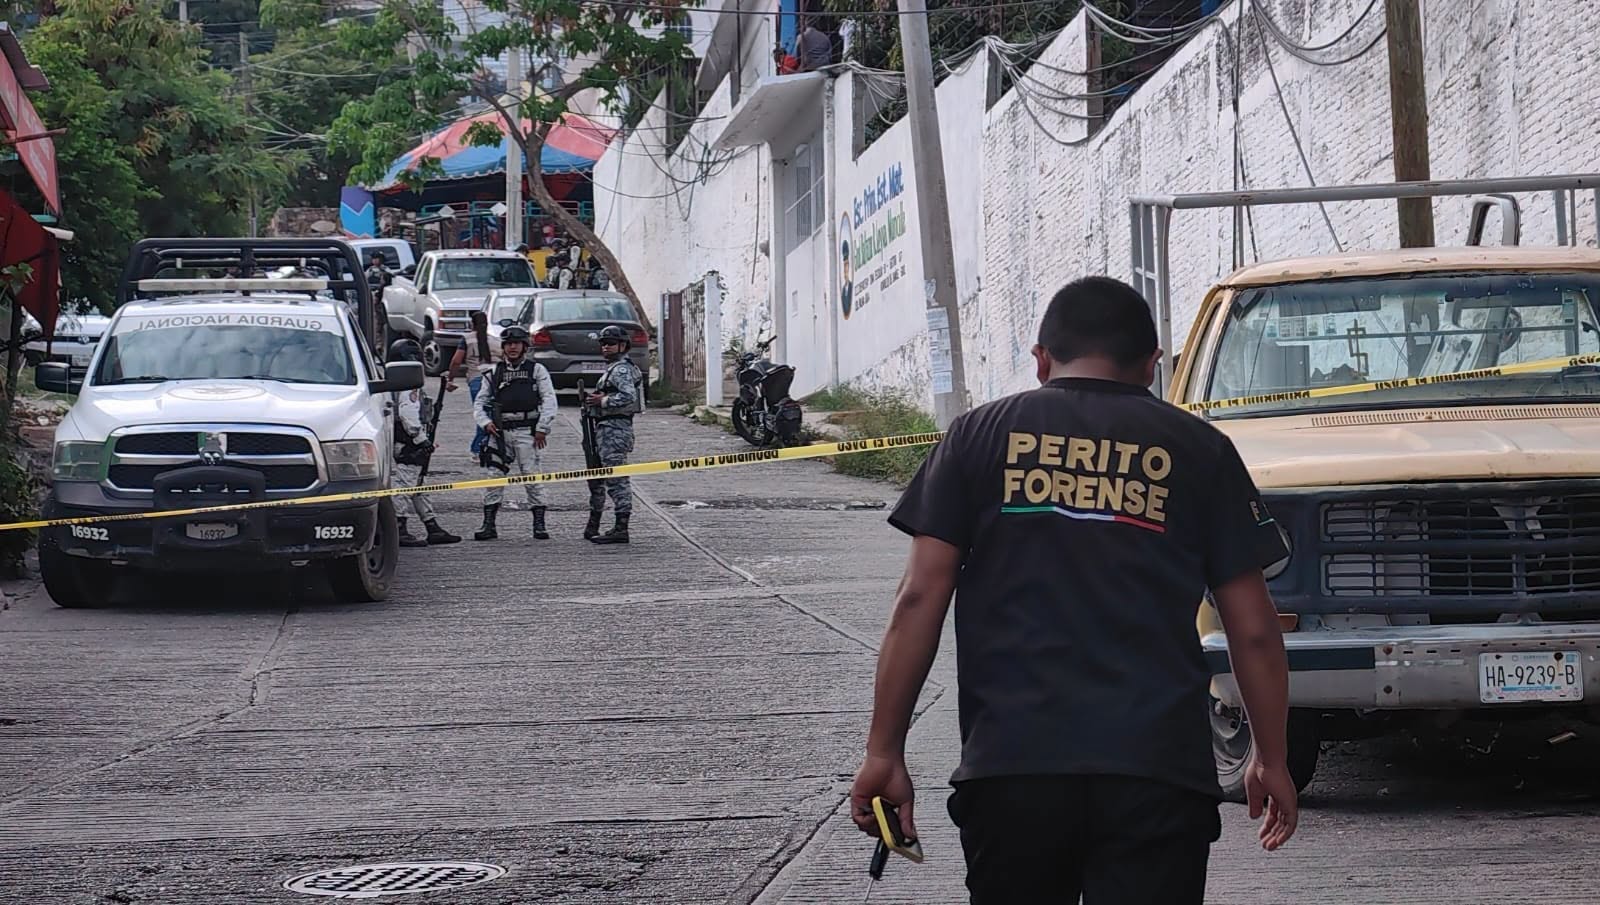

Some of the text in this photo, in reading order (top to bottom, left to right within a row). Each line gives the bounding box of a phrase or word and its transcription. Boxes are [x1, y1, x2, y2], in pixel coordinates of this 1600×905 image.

[1006, 432, 1172, 481] PERITO
[1003, 468, 1169, 522] FORENSE
[70, 525, 109, 540] 16932
[314, 526, 354, 539] 16932
[1485, 664, 1575, 687] HA-9239-B
